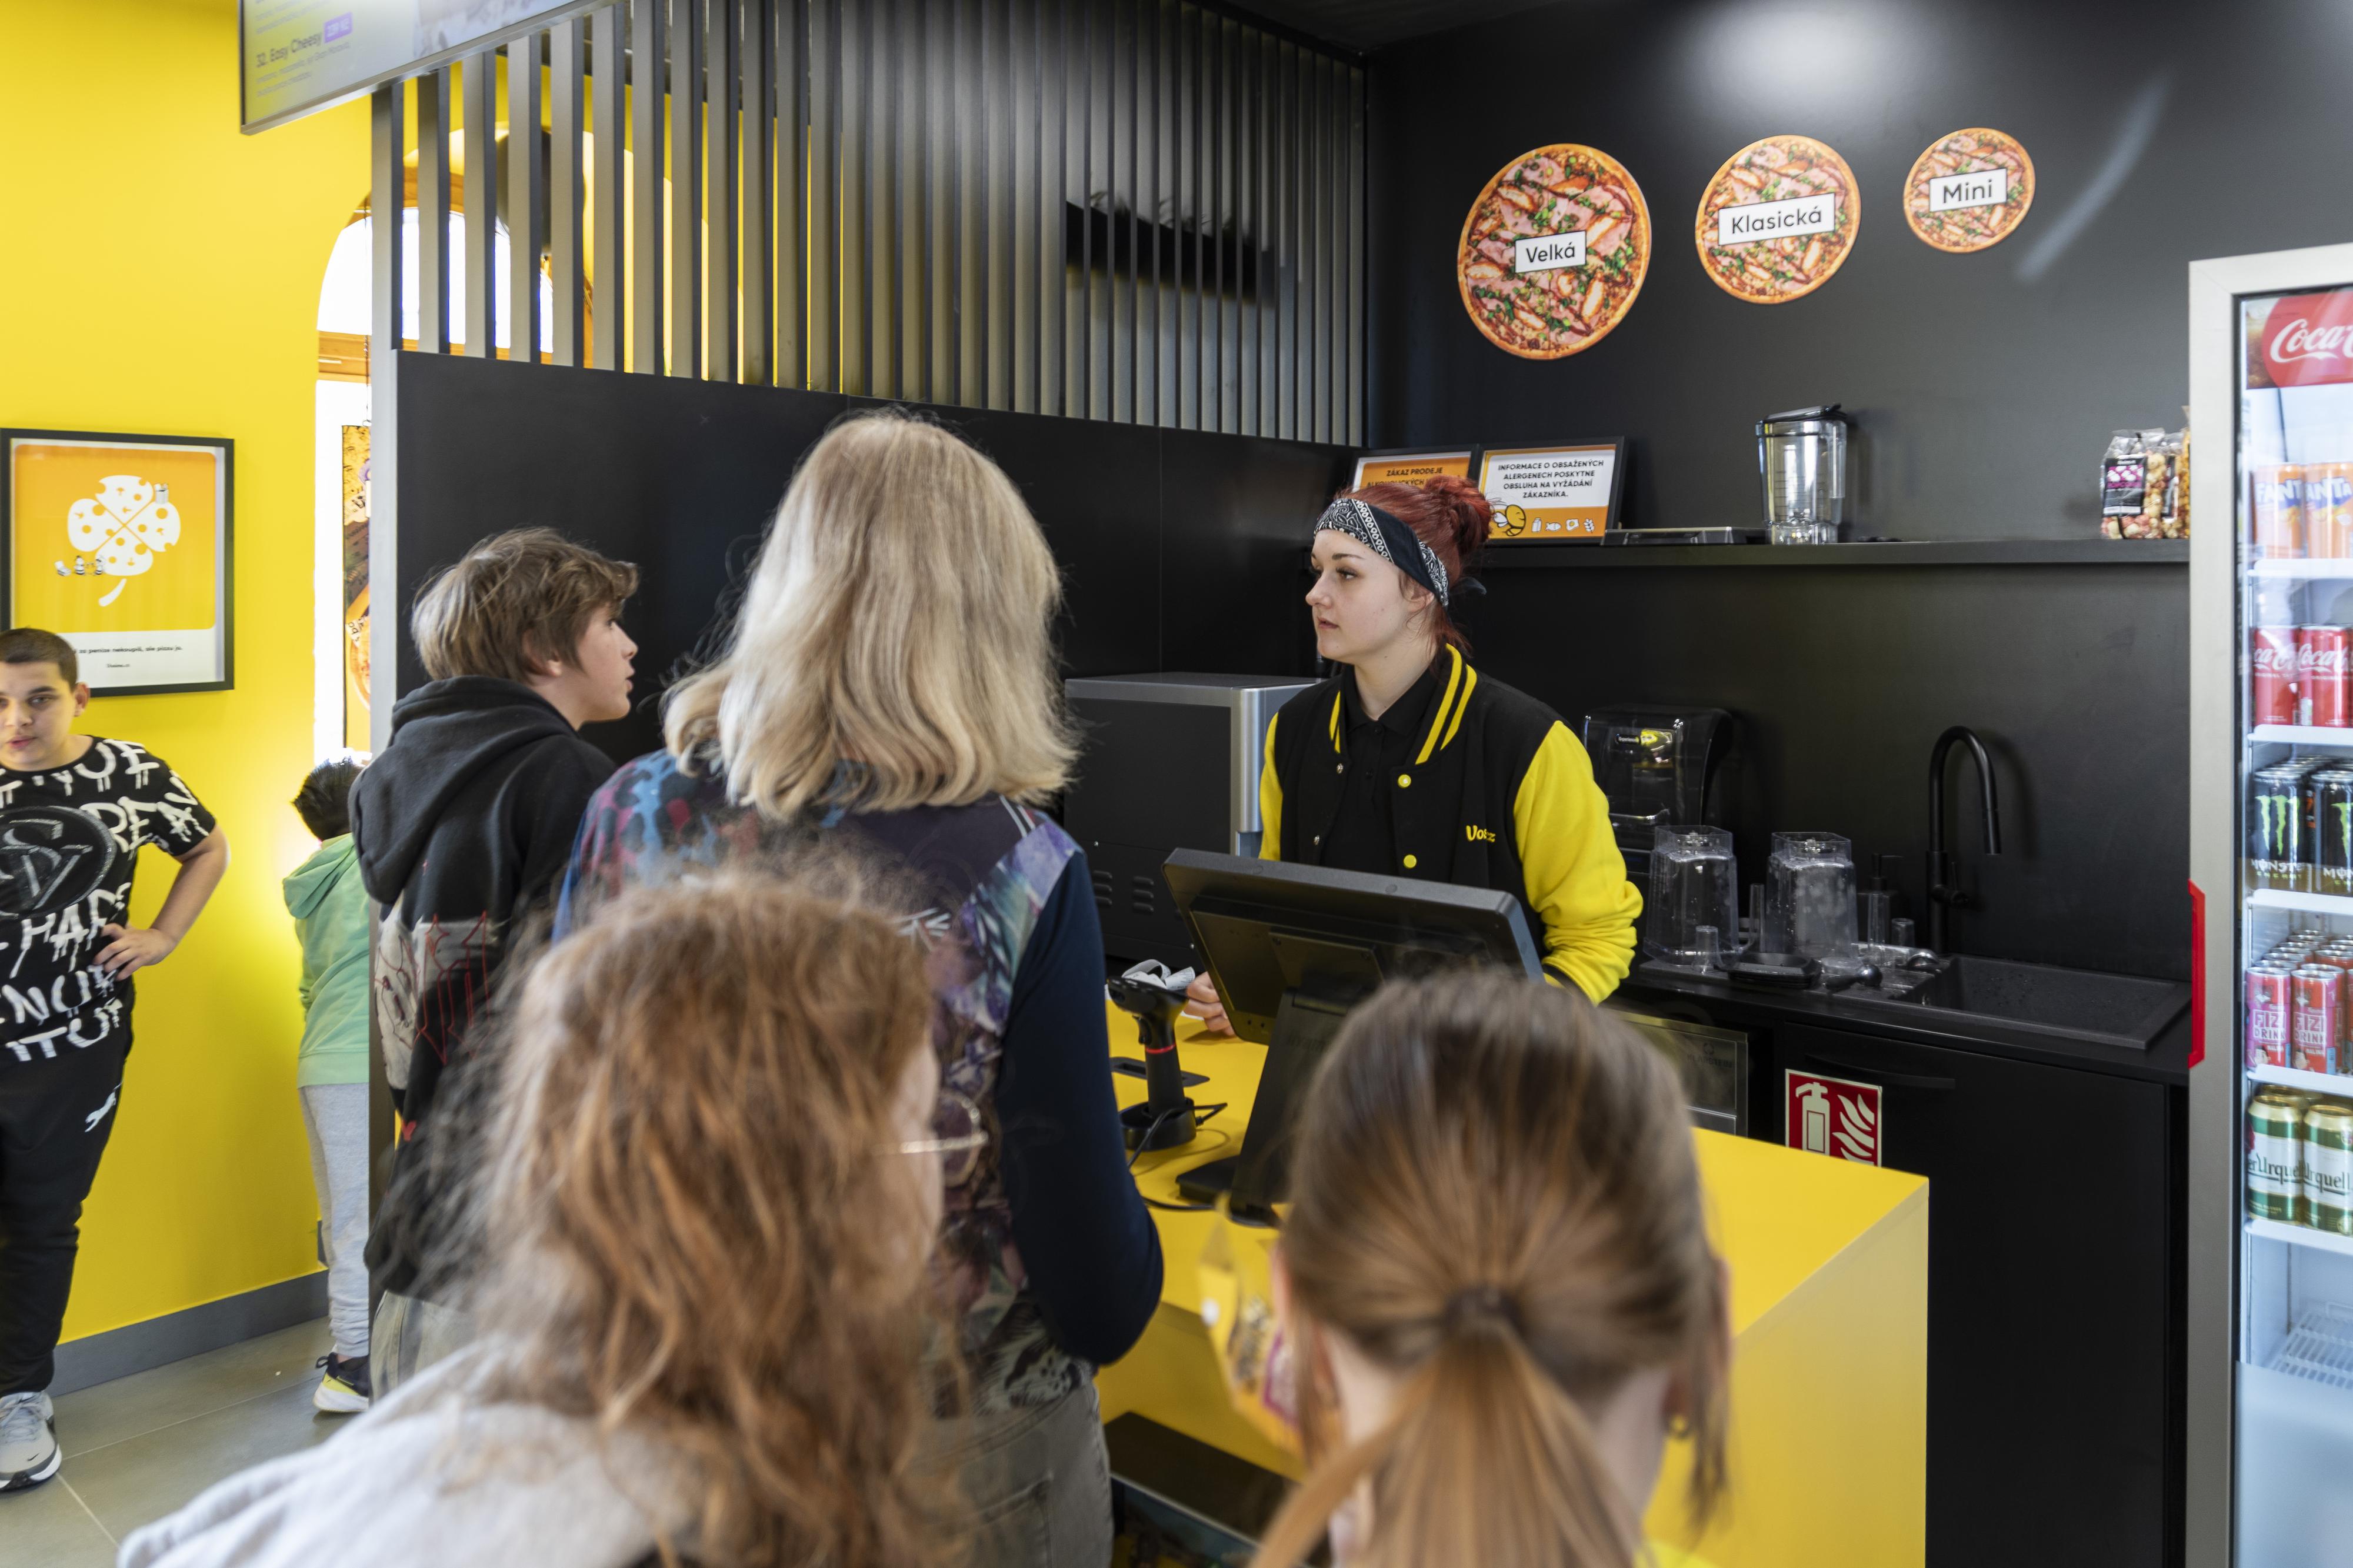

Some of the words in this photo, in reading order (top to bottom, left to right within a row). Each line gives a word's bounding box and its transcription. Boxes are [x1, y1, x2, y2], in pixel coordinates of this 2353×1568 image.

[1942, 179, 1993, 204] Mini
[1731, 206, 1822, 235] Klasická
[1525, 241, 1575, 263] Velká
[1498, 462, 1542, 471] INFORMACE
[1552, 459, 1604, 468] OBSAŽENÝCH
[1387, 468, 1409, 476] ZÁKAZ
[1503, 472, 1552, 480] ALERGENECH
[1552, 478, 1594, 488] VYŽÁDÁNÍ
[1522, 489, 1568, 498] ZÁKAZNÍKA.
